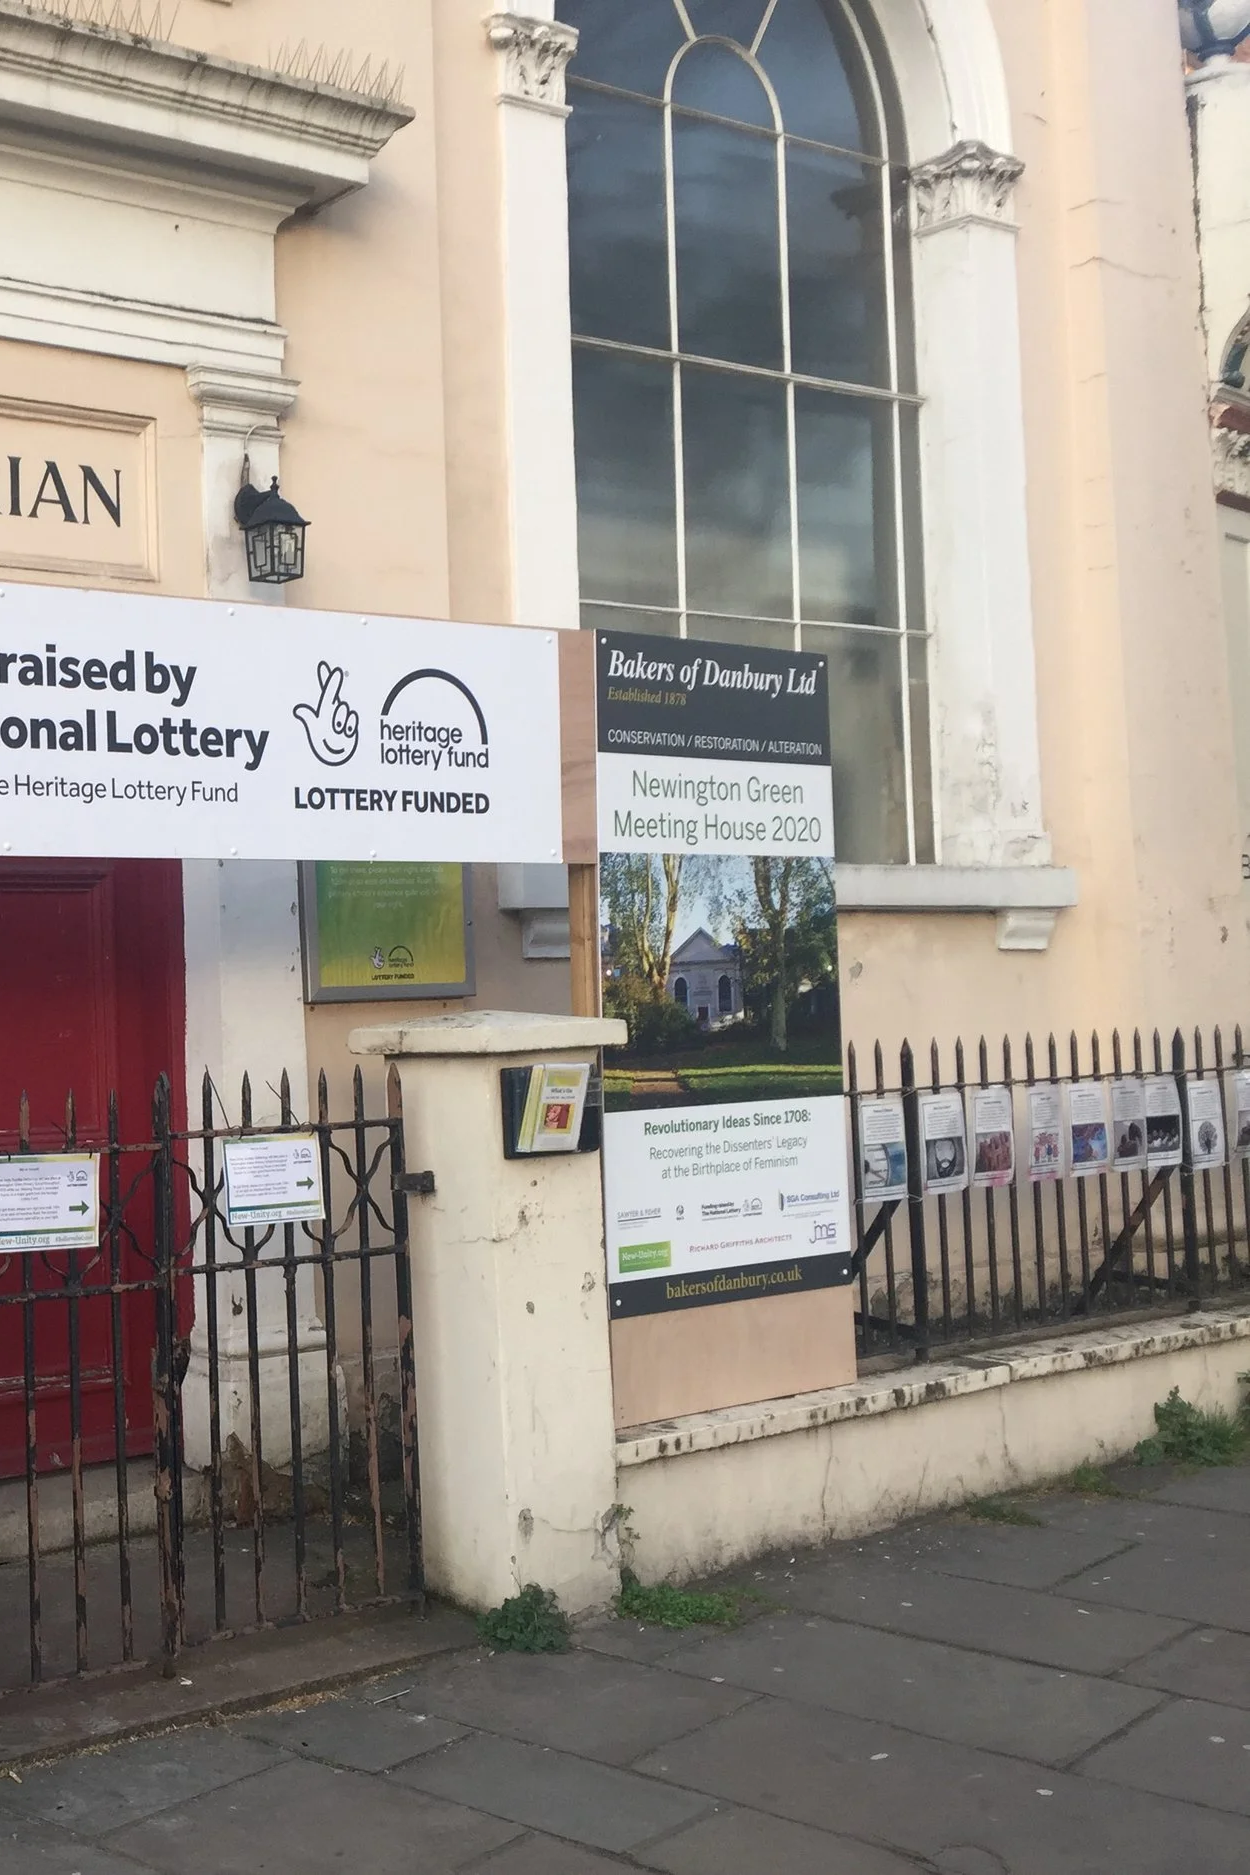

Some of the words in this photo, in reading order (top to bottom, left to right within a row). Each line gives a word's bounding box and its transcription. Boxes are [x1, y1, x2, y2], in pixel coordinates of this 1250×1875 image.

[145, 651, 197, 708] by
[608, 650, 674, 682] Bakers
[680, 658, 702, 691] of
[702, 660, 783, 698] Danbury
[786, 668, 816, 696] Ltd
[608, 687, 661, 703] Established
[665, 692, 686, 706] 1878
[107, 710, 270, 772] Lottery
[380, 718, 462, 748] heritage
[608, 729, 685, 747] CONSERVATION
[695, 736, 760, 752] RESTORATION
[768, 740, 822, 756] ALTERATION
[380, 743, 442, 770] lottery
[448, 746, 489, 768] fund
[14, 774, 107, 804] Heritage
[111, 778, 187, 807] Lottery
[192, 781, 238, 803] Fund
[294, 786, 398, 812] LOTTERY
[402, 790, 490, 814] FUNDED
[632, 770, 740, 806] Newington
[747, 776, 803, 804] Green
[614, 810, 698, 846] Meeting
[704, 814, 766, 841] House
[772, 816, 821, 842] 2020
[644, 1118, 719, 1136] Revolutionary
[722, 1115, 750, 1129] Ideas
[754, 1112, 781, 1126] Since
[784, 1110, 811, 1124] 1708:
[650, 1145, 703, 1160] Recovering
[706, 1142, 720, 1155] the
[776, 1136, 808, 1149] Legacy
[662, 1168, 671, 1179] at
[674, 1164, 690, 1178] the
[692, 1160, 740, 1177] Birthplace
[743, 1157, 752, 1170] of
[754, 1154, 798, 1168] Feminism
[800, 1192, 830, 1202] Consulting
[831, 1190, 840, 1198] Ltd
[690, 1243, 718, 1252] RICHARD
[720, 1239, 754, 1249] GRIFFITHS
[755, 1234, 792, 1244] ARCHITECTS
[810, 1221, 836, 1243] jms
[666, 1264, 802, 1299] bakersofdanbury.co.uk
